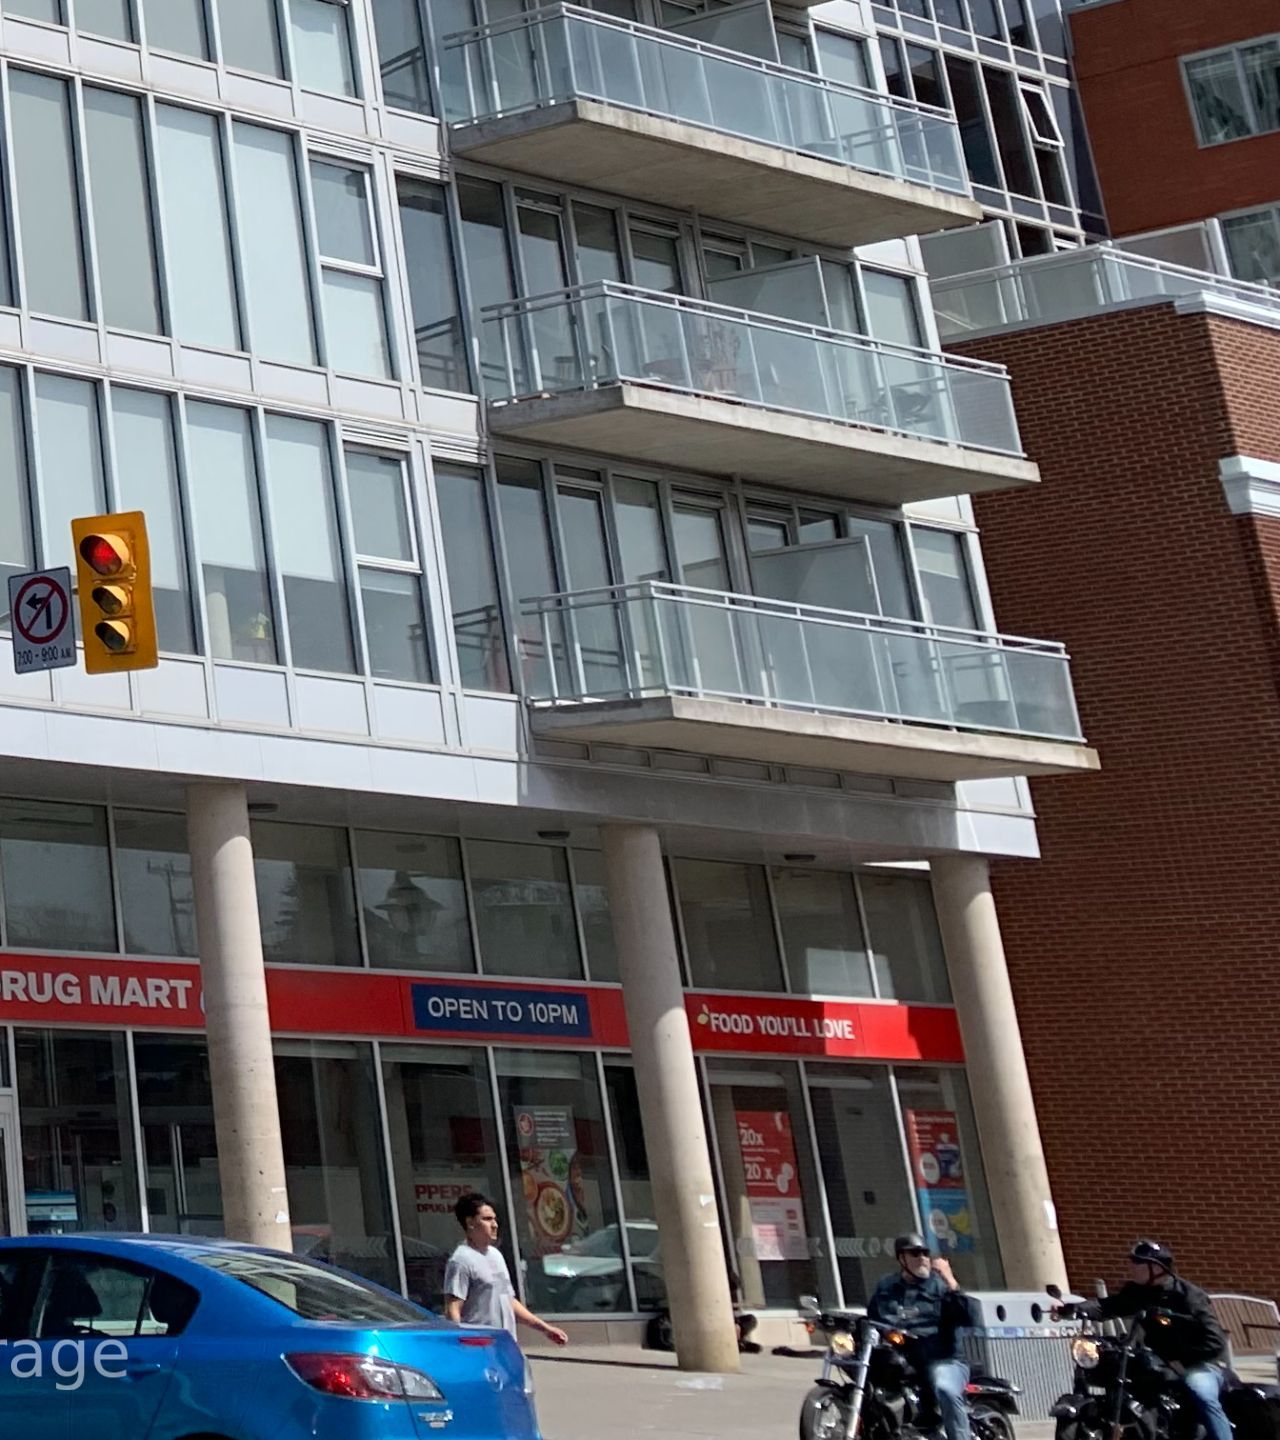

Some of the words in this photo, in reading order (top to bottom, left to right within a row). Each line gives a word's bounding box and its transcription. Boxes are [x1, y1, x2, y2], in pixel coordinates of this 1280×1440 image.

[90, 975, 193, 1009] MART
[428, 996, 489, 1020] OPEN
[492, 1001, 523, 1022] TO
[528, 1003, 579, 1025] 10PM
[710, 1013, 754, 1035] FOOD
[757, 1015, 812, 1037] YOU'LL
[813, 1018, 856, 1040] LOVE
